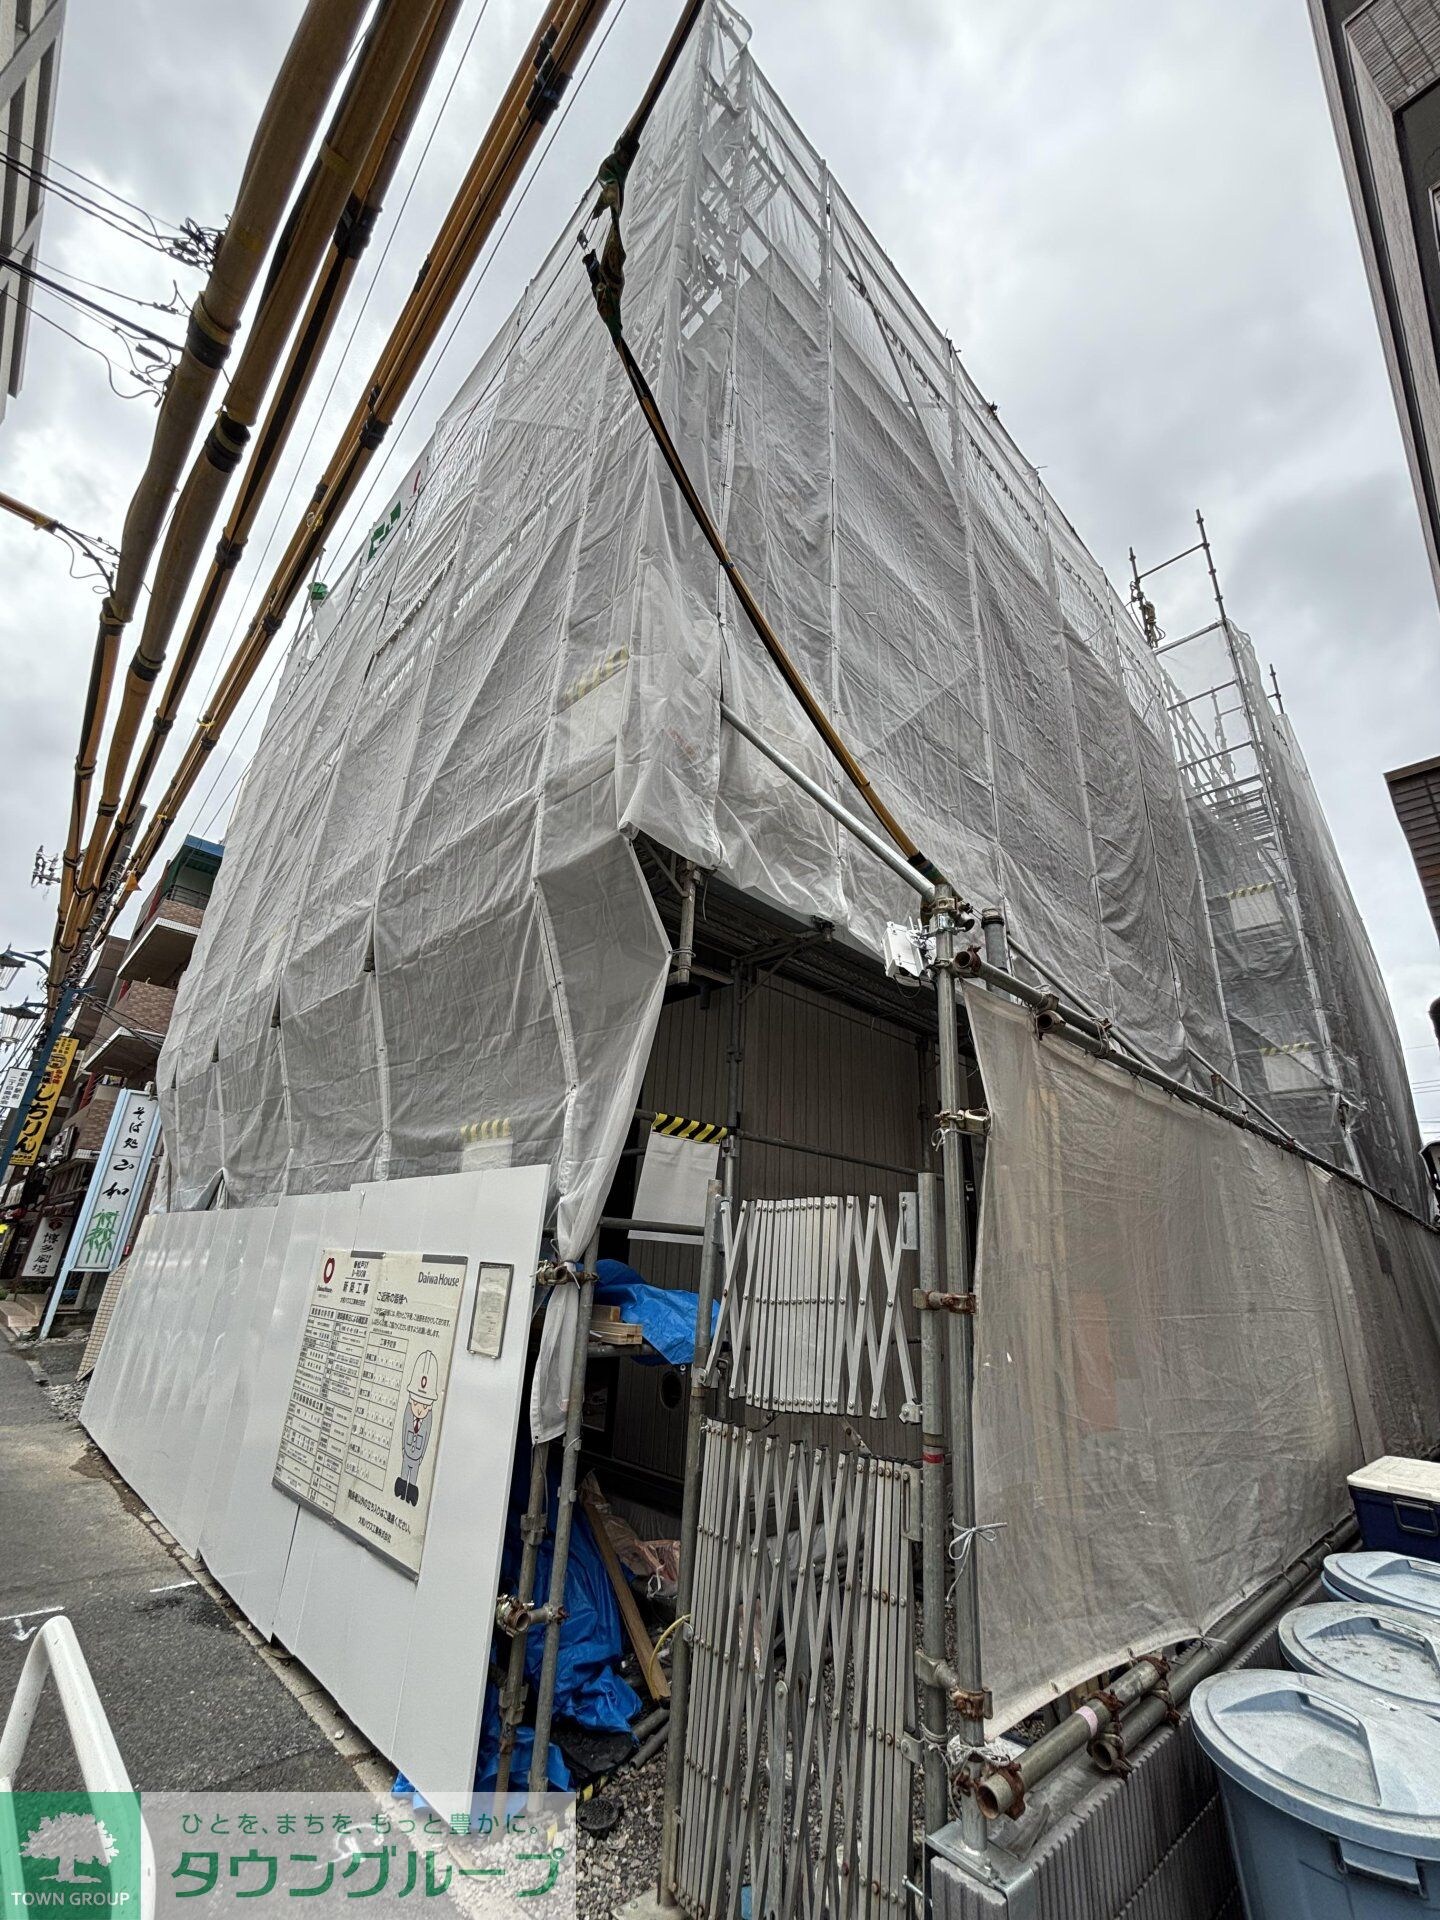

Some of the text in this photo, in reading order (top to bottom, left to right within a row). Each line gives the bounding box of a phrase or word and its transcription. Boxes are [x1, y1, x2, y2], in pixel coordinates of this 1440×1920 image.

[14, 1084, 55, 1153] しちりん
[102, 1106, 145, 1199] そば処 山和
[32, 1232, 59, 1274] 博多劇場
[342, 1281, 369, 1295] 新築工事
[418, 1271, 460, 1287] Daiwa House
